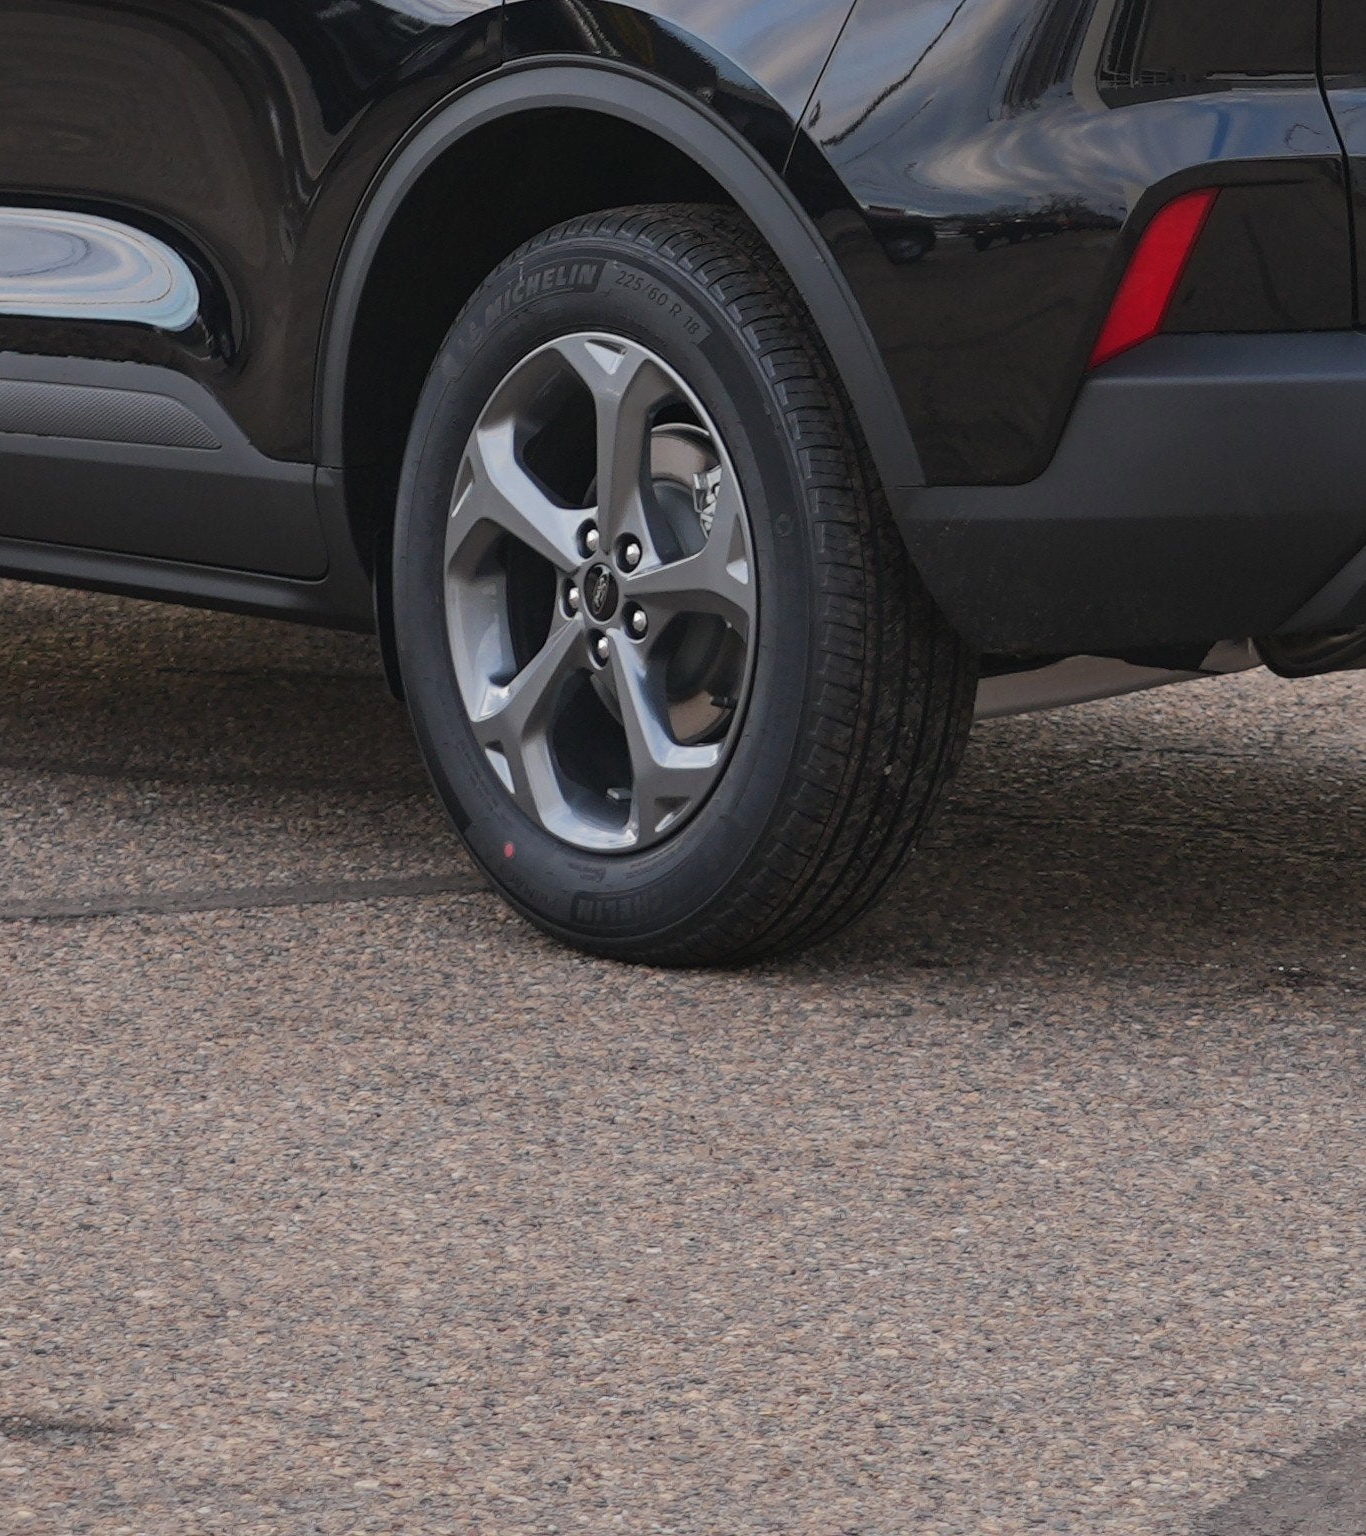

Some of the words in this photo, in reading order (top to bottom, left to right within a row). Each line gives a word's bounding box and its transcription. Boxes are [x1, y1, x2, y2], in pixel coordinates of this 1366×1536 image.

[486, 263, 598, 327] MICHELIN
[615, 270, 669, 306] 225/60
[669, 303, 682, 317] R
